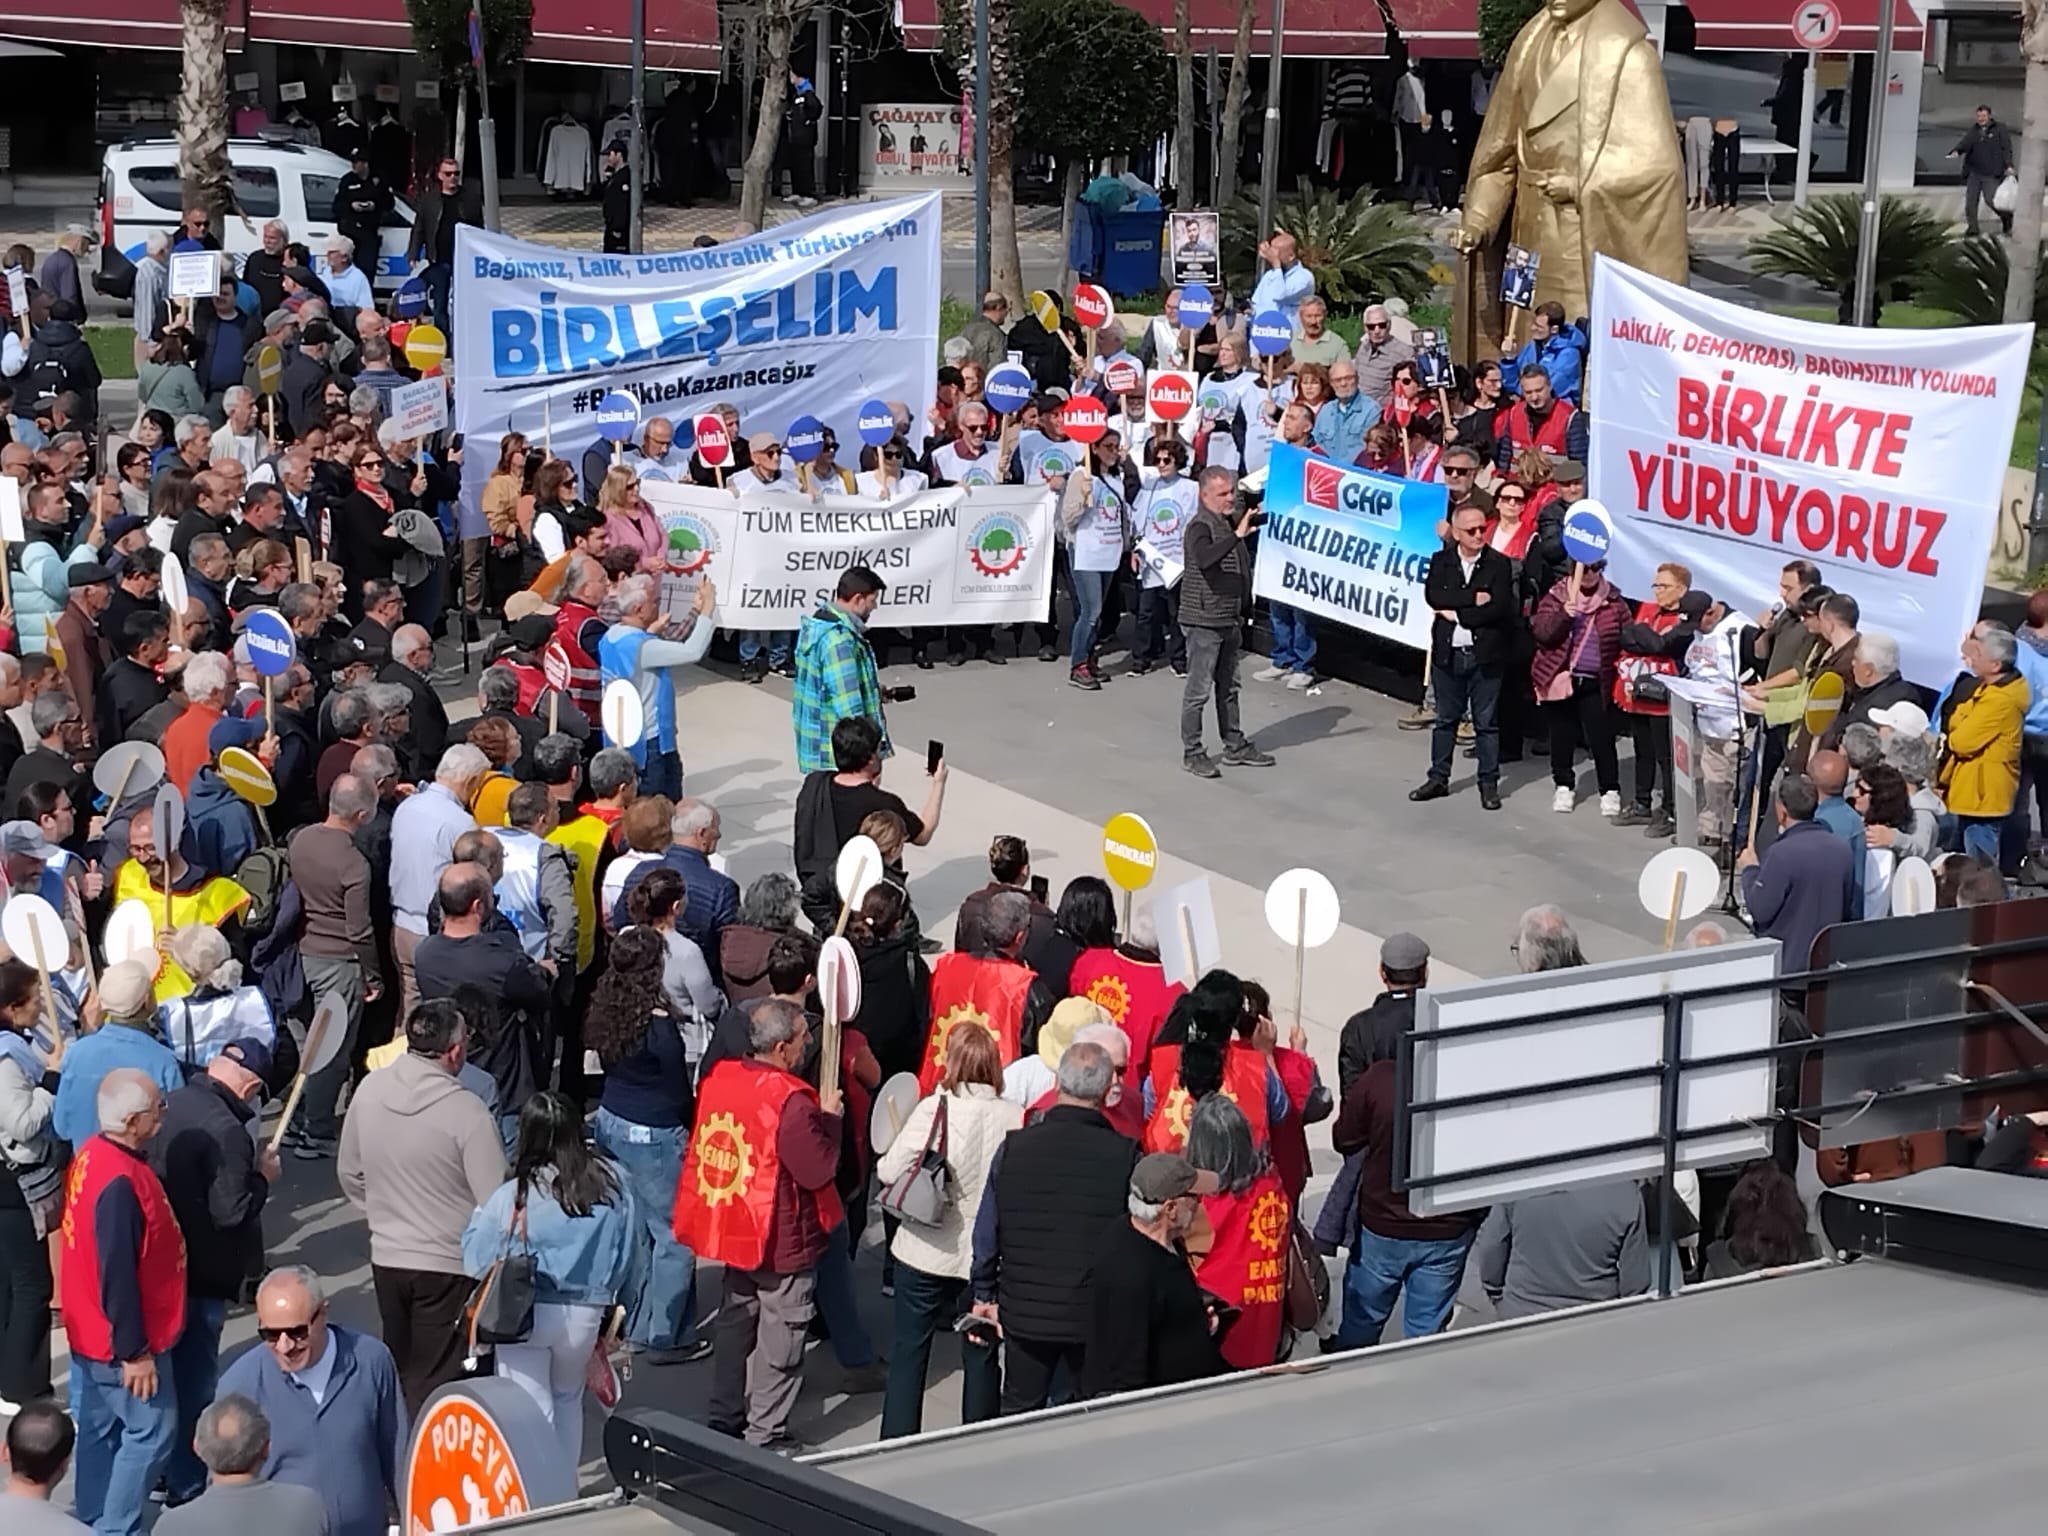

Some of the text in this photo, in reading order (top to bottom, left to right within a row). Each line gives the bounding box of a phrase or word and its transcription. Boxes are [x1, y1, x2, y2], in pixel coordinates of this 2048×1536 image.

[869, 107, 945, 126] ÇAĞATAY
[474, 256, 573, 281] Bağımsız,
[636, 244, 777, 275] Demokratik
[492, 265, 897, 378] BİRLEŞELİM
[1611, 317, 1676, 352] LAİKLİK,
[1919, 368, 1997, 398] YOLUNDA
[1150, 386, 1193, 404] LAİKLİK
[1063, 409, 1106, 427] LAİKLİK
[1676, 370, 1913, 478] BİRLİKTE
[1342, 482, 1393, 517] CHP
[1628, 443, 1947, 577] YÜRÜYORUZ
[742, 507, 793, 533] TÜM
[785, 546, 911, 571] SENDİKASI
[1267, 511, 1431, 585] NARLIDERE İLÇE
[740, 583, 807, 609] İZMİR
[1282, 561, 1410, 626] BAŞKANLIĞI
